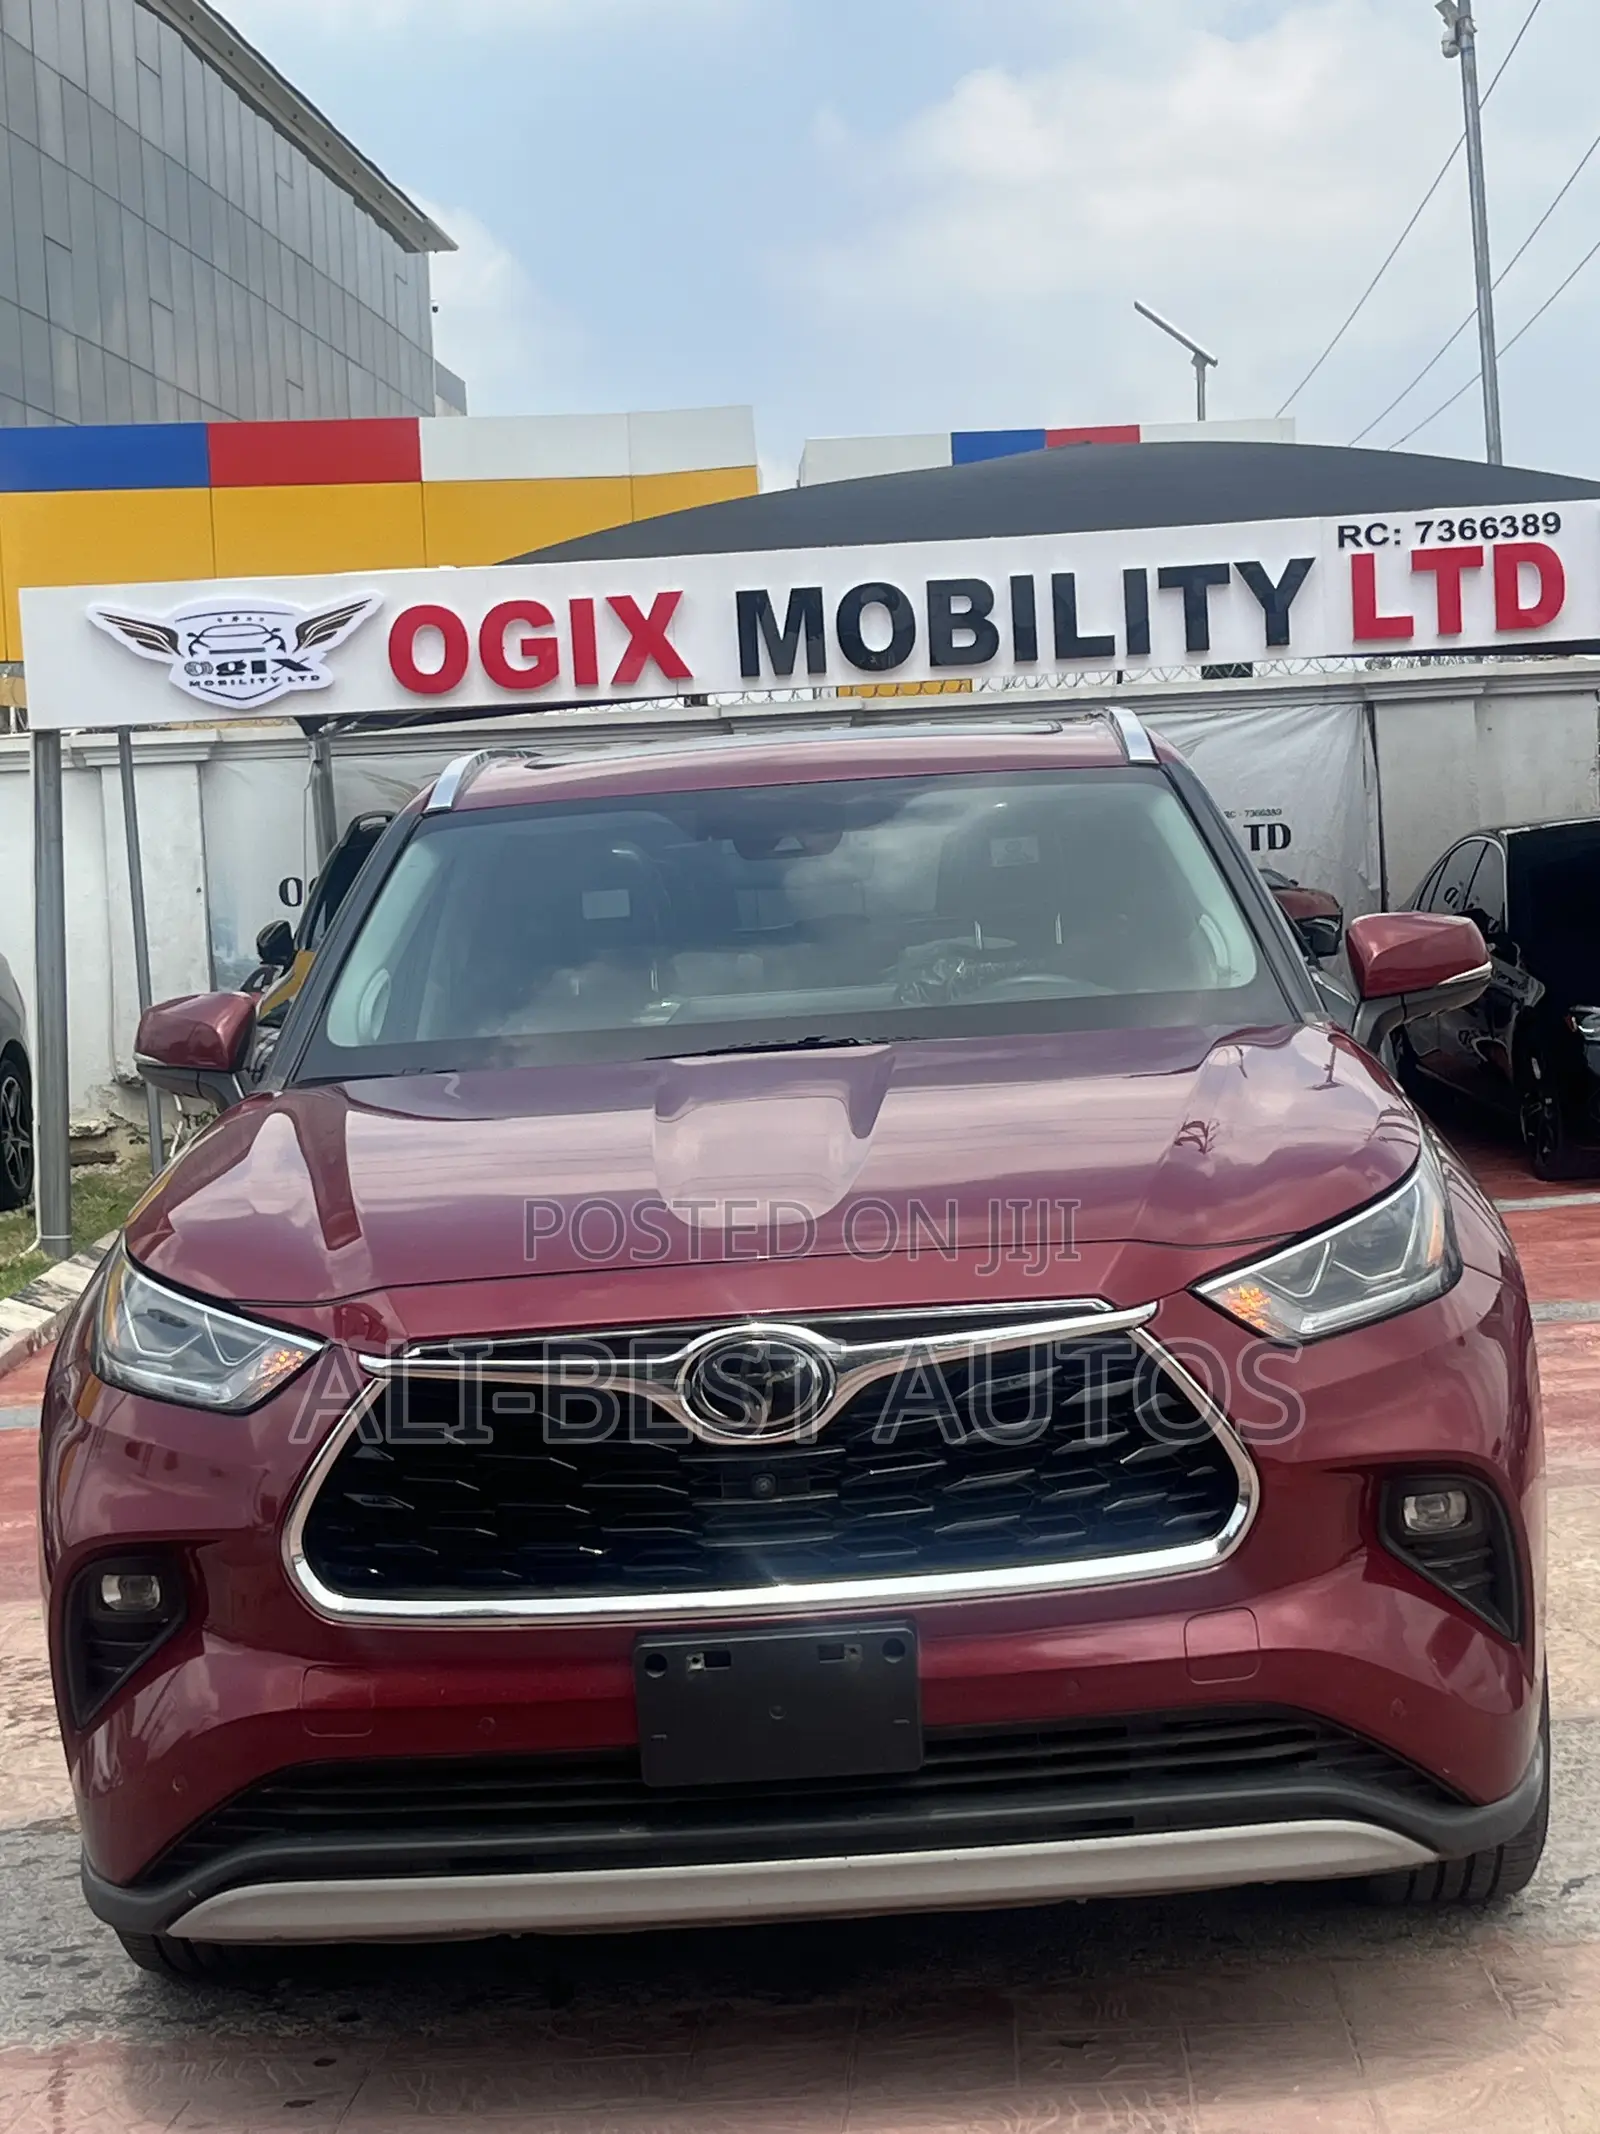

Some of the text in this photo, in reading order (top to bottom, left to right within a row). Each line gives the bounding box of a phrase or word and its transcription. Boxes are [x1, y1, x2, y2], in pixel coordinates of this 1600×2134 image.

[1337, 511, 1562, 548] RC: 7366389
[387, 541, 1566, 695] OGIX MOBILITY LTD
[189, 674, 321, 687] MOBILITY LTD
[1243, 823, 1292, 851] TD
